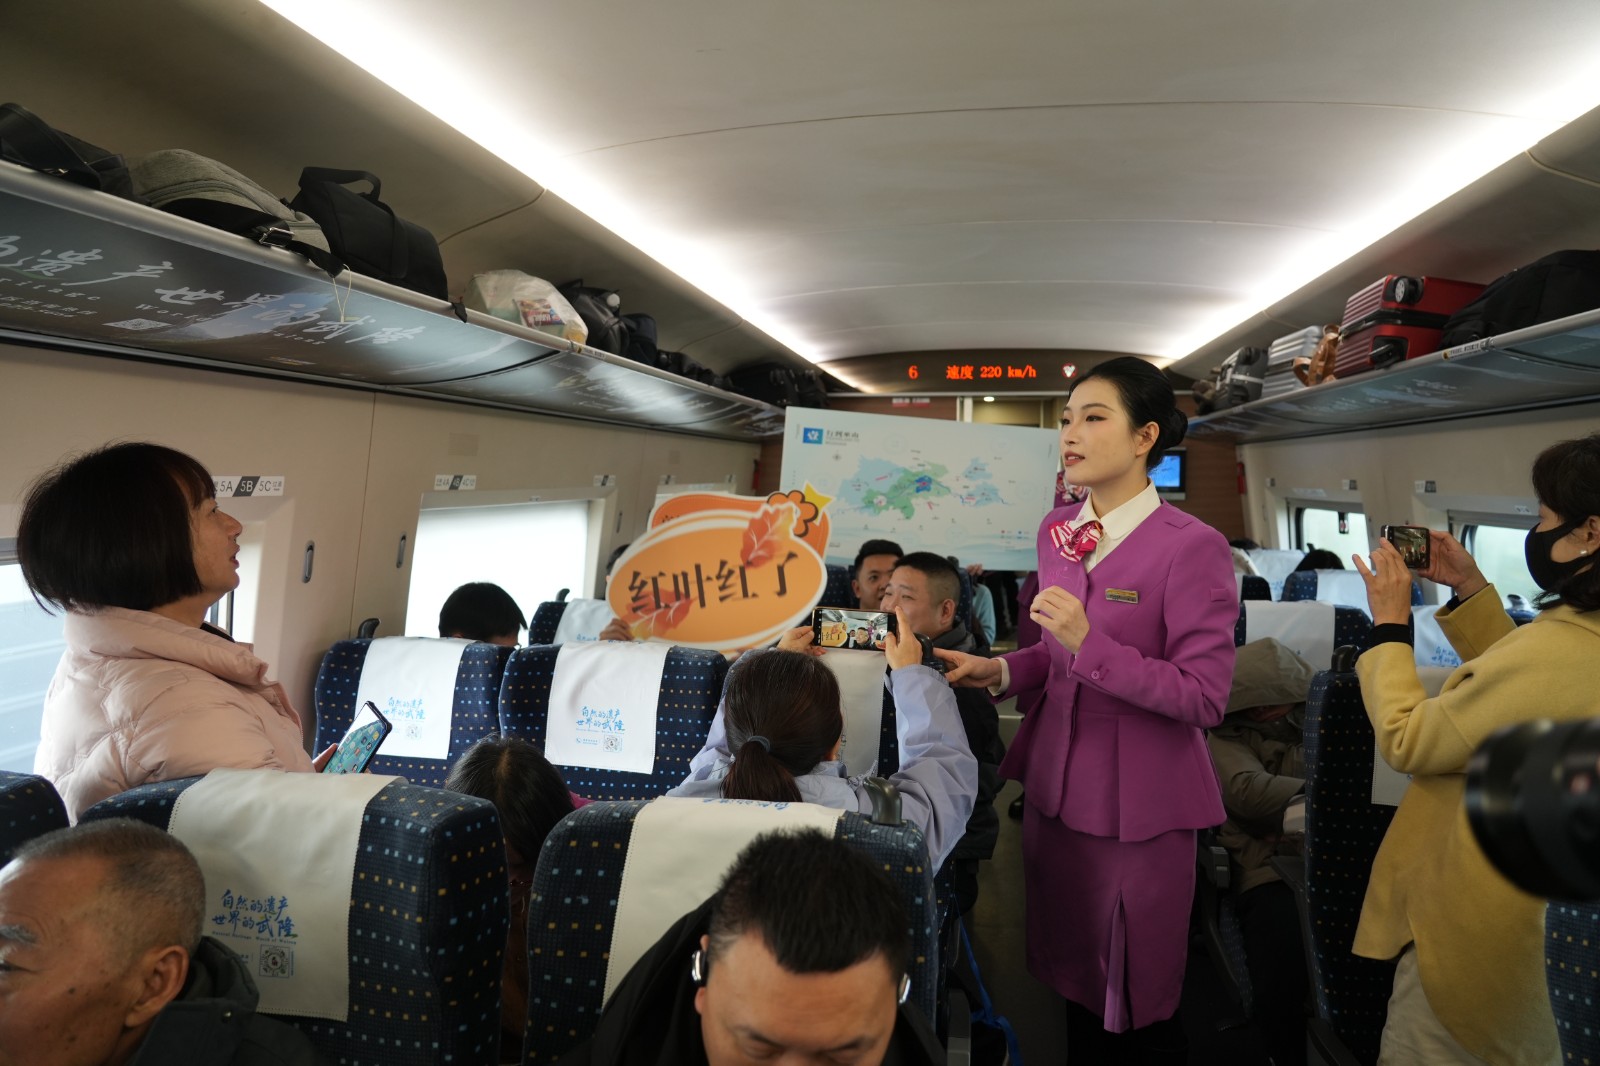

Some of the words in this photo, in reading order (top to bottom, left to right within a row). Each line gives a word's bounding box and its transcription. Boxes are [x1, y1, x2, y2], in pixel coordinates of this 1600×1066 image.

[908, 365, 919, 380] 6
[946, 365, 974, 380] 速度
[980, 366, 1002, 378] 220
[1008, 365, 1037, 378] km/h
[219, 480, 233, 492] 5A
[240, 480, 254, 492] 5B
[259, 480, 272, 492] 5C
[628, 551, 799, 613] 红叶红了
[221, 889, 288, 921] 自然的遗产
[212, 910, 298, 938] 世界的武隆
